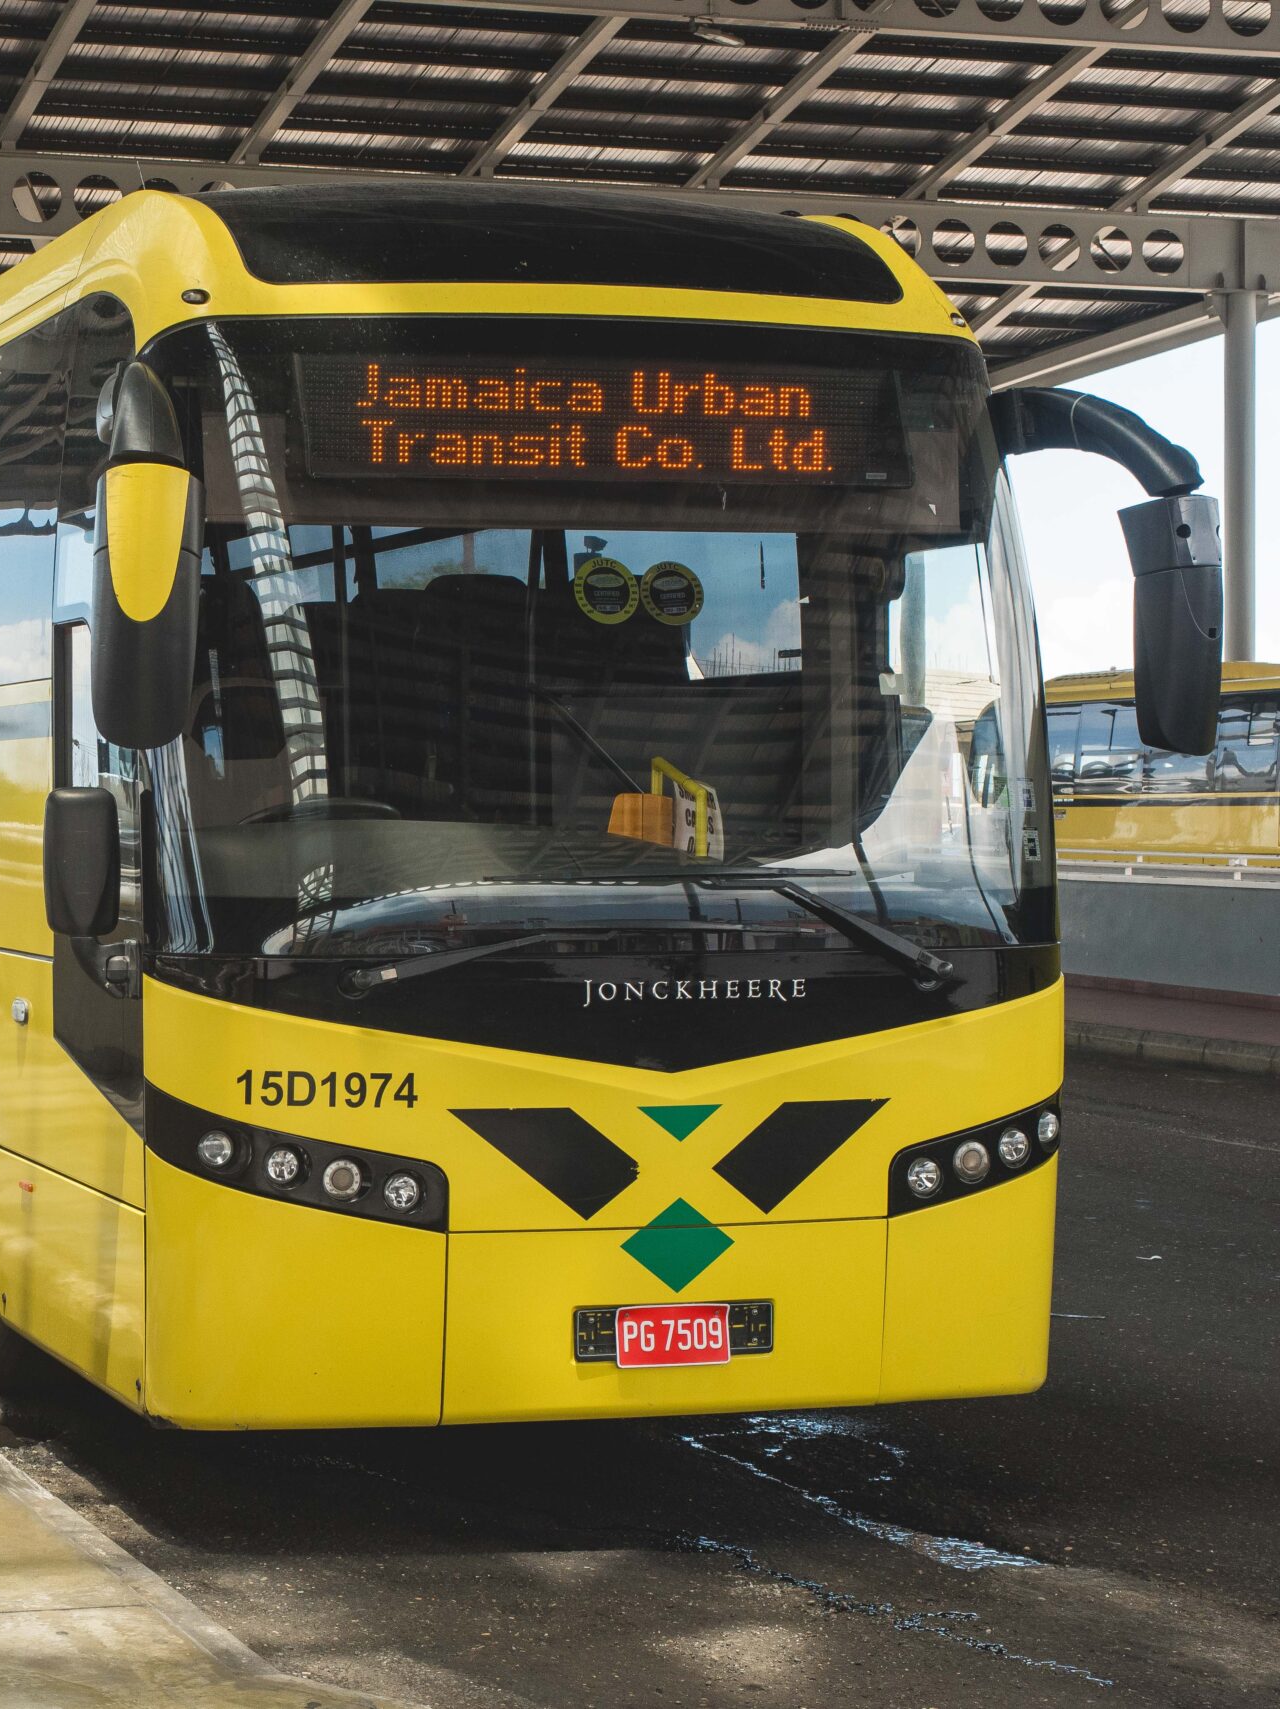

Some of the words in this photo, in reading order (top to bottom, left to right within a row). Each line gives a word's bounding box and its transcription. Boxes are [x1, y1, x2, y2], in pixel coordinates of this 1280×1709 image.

[356, 363, 604, 413] Jamaica
[631, 371, 811, 417] Urban
[362, 419, 587, 468] Transit
[615, 424, 704, 470] Co.
[731, 427, 833, 472] Ltd.
[591, 558, 618, 568] JUTC
[582, 977, 807, 1008] JONCKHEERE
[236, 1069, 419, 1109] 15D1974
[622, 1320, 656, 1354] PG
[661, 1317, 723, 1352] 7509
